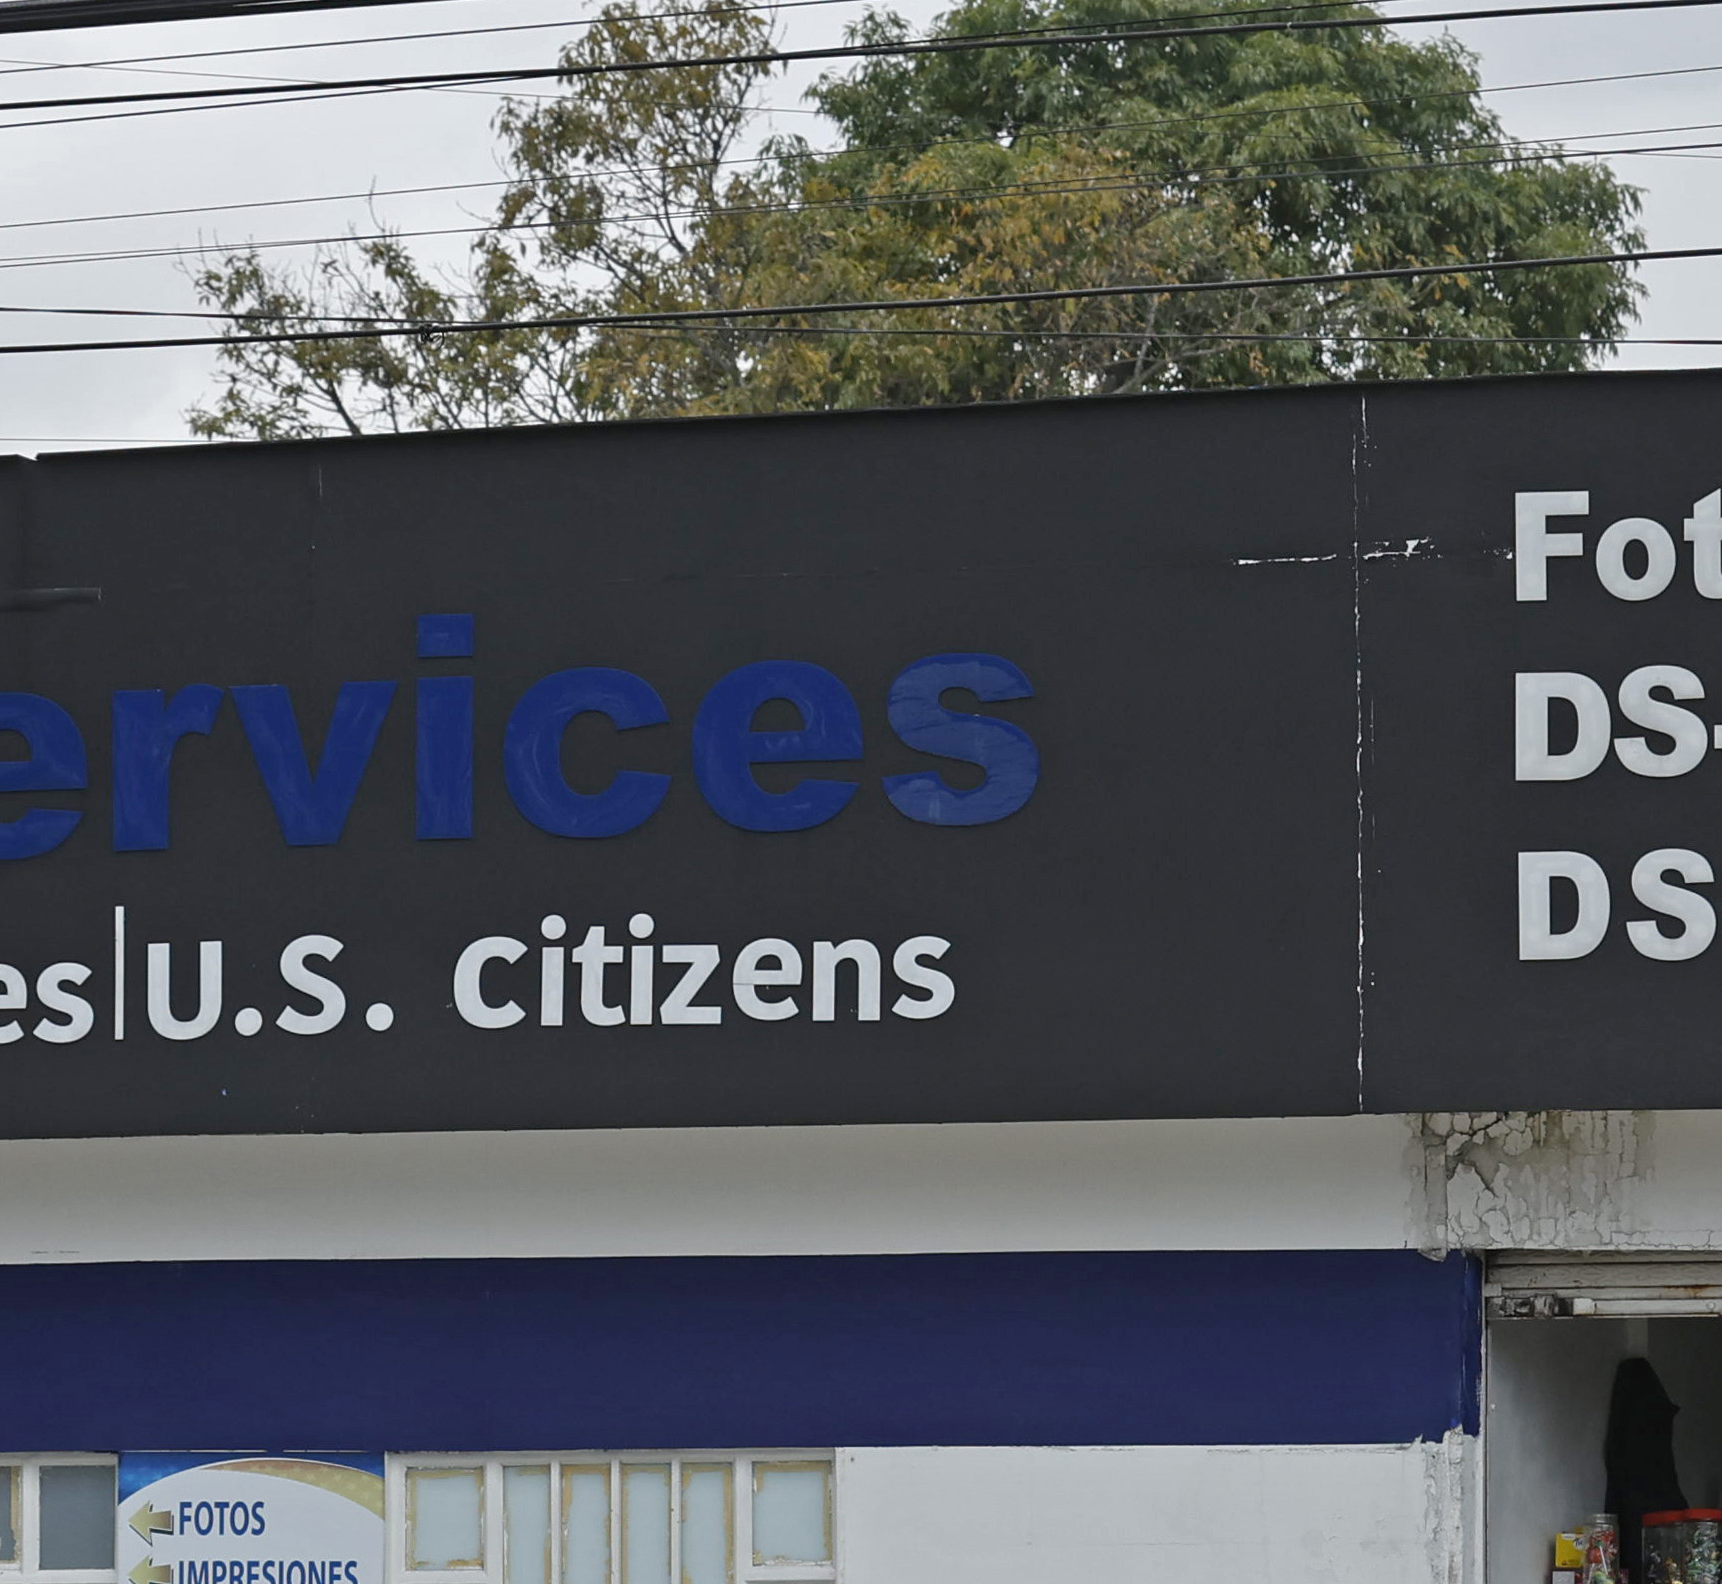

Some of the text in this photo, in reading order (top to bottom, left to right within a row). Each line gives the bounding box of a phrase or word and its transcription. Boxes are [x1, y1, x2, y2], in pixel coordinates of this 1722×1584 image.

[146, 933, 395, 1042] U.S.
[452, 912, 956, 1030] Citizens
[179, 1500, 266, 1536] FOTOS
